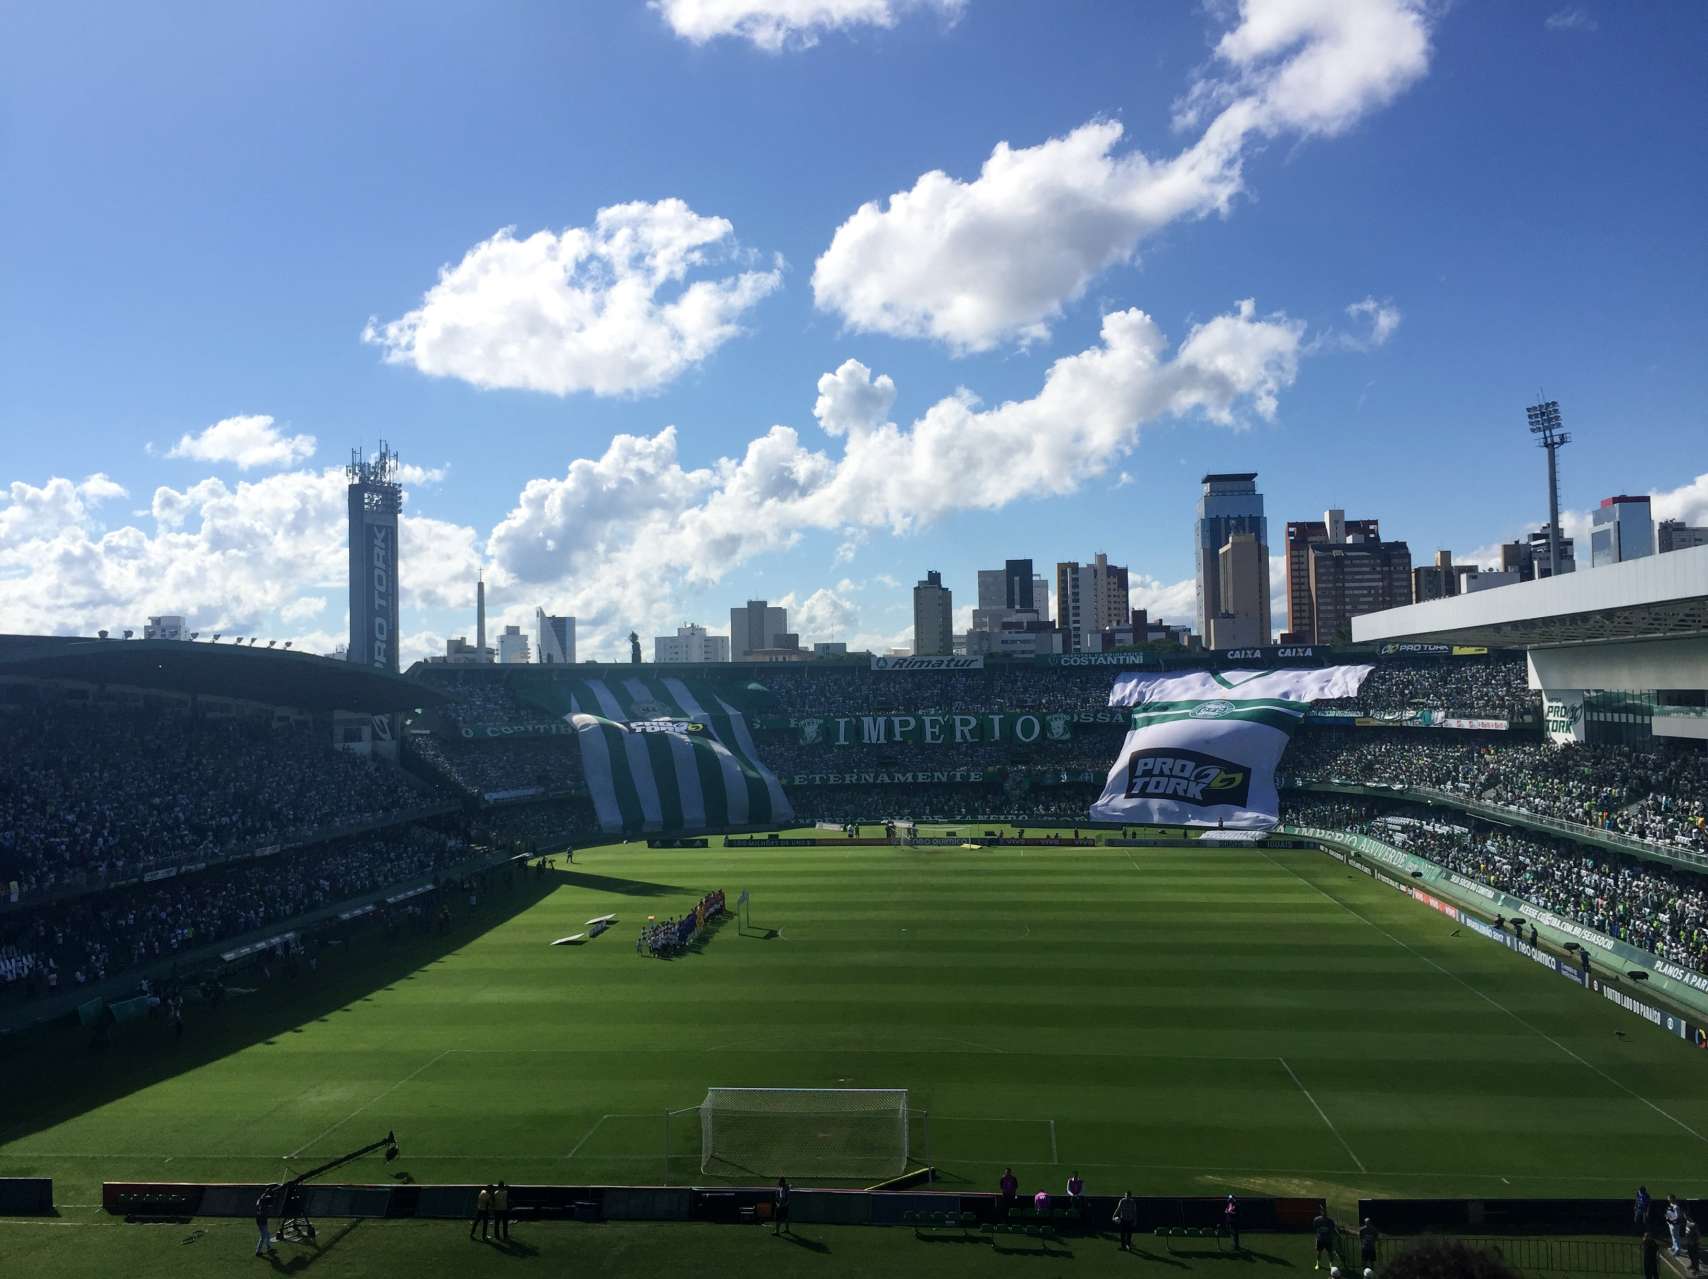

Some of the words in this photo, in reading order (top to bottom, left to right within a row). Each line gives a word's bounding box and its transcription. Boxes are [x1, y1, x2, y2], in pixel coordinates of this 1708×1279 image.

[374, 526, 387, 610] TORK
[1227, 649, 1262, 659] CAIXA
[1278, 647, 1314, 657] CAIXA
[891, 656, 979, 669] Rimatur
[1061, 655, 1145, 666] COSTANTINI
[1546, 705, 1568, 718] PRO
[487, 723, 577, 737] CORITIB
[1546, 719, 1572, 734] TORK
[1134, 757, 1197, 781] PRO
[793, 771, 984, 785] ETERNAMENTE
[1131, 776, 1208, 801] TORK
[1654, 960, 1685, 980] PLANOS
[1690, 975, 1708, 993] PAR
